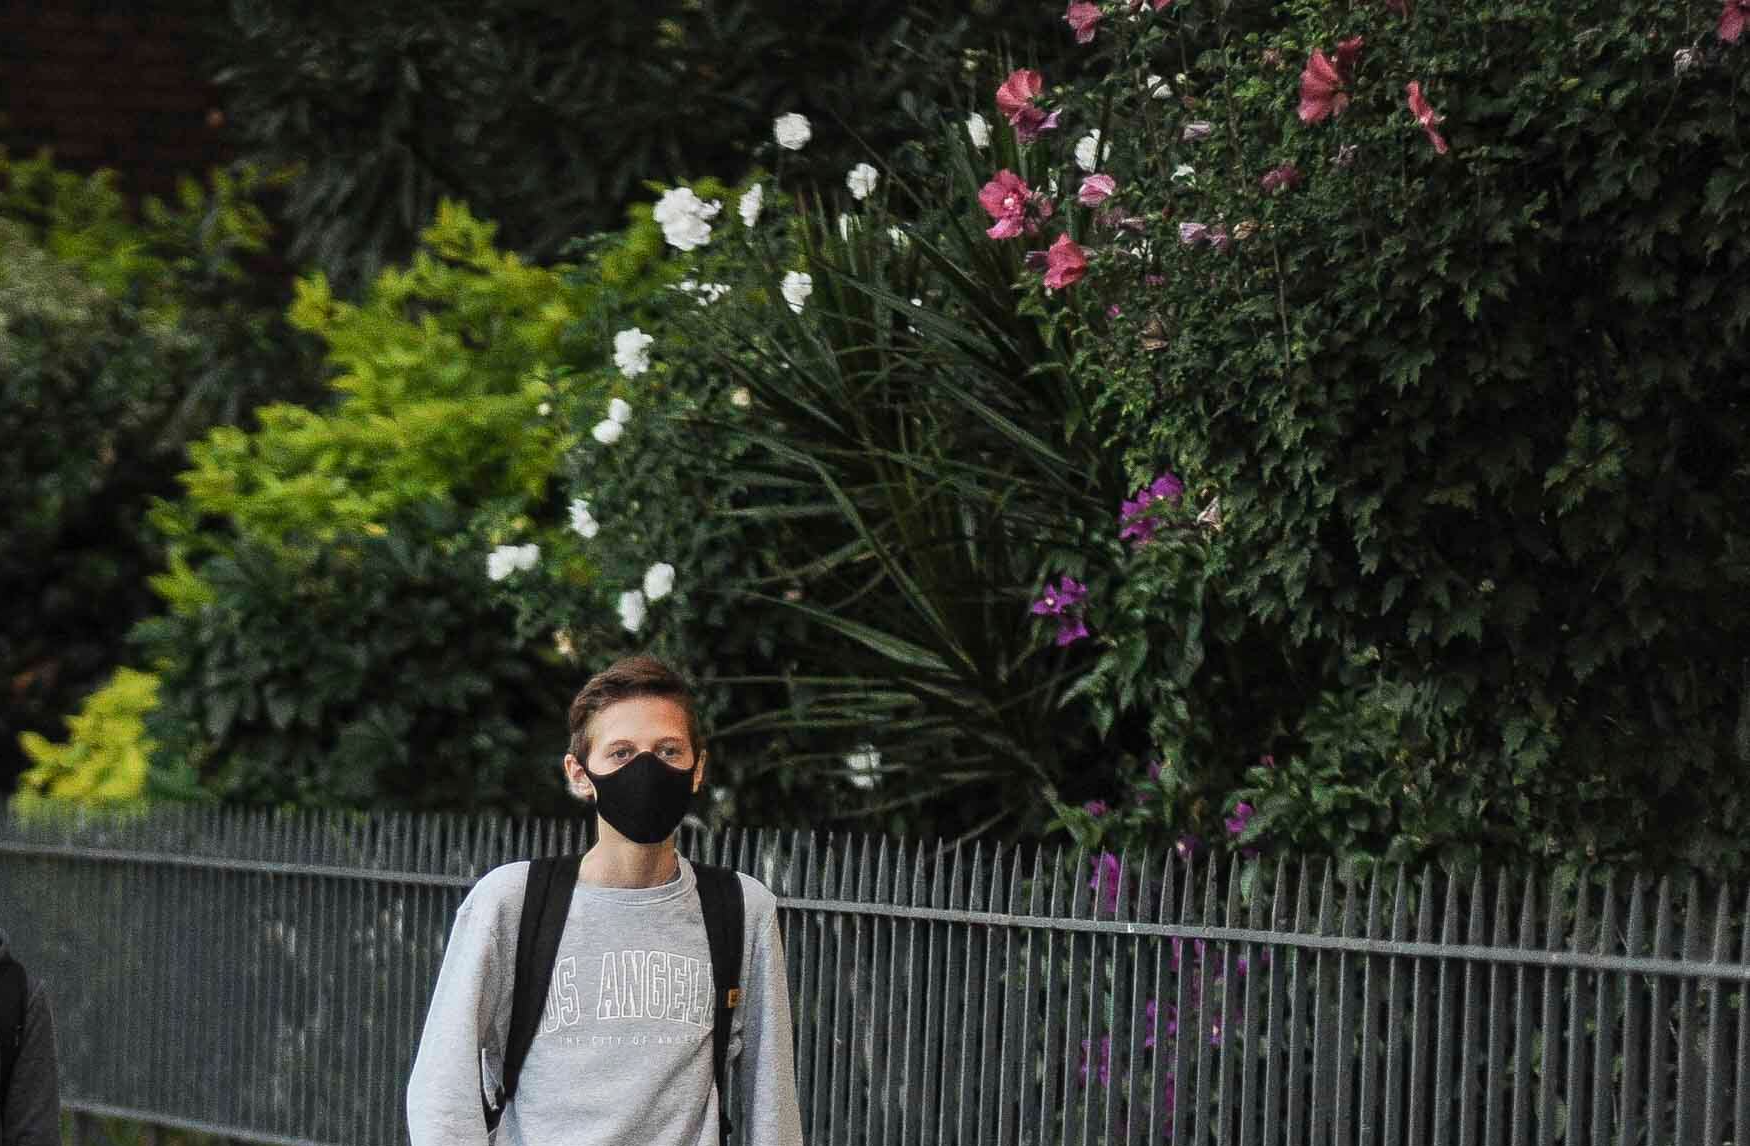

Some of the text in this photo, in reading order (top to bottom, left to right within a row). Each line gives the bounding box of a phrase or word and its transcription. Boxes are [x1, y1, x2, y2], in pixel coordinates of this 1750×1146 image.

[540, 956, 580, 1033] OS
[592, 1035, 621, 1046] CITY
[633, 1035, 648, 1046] OF
